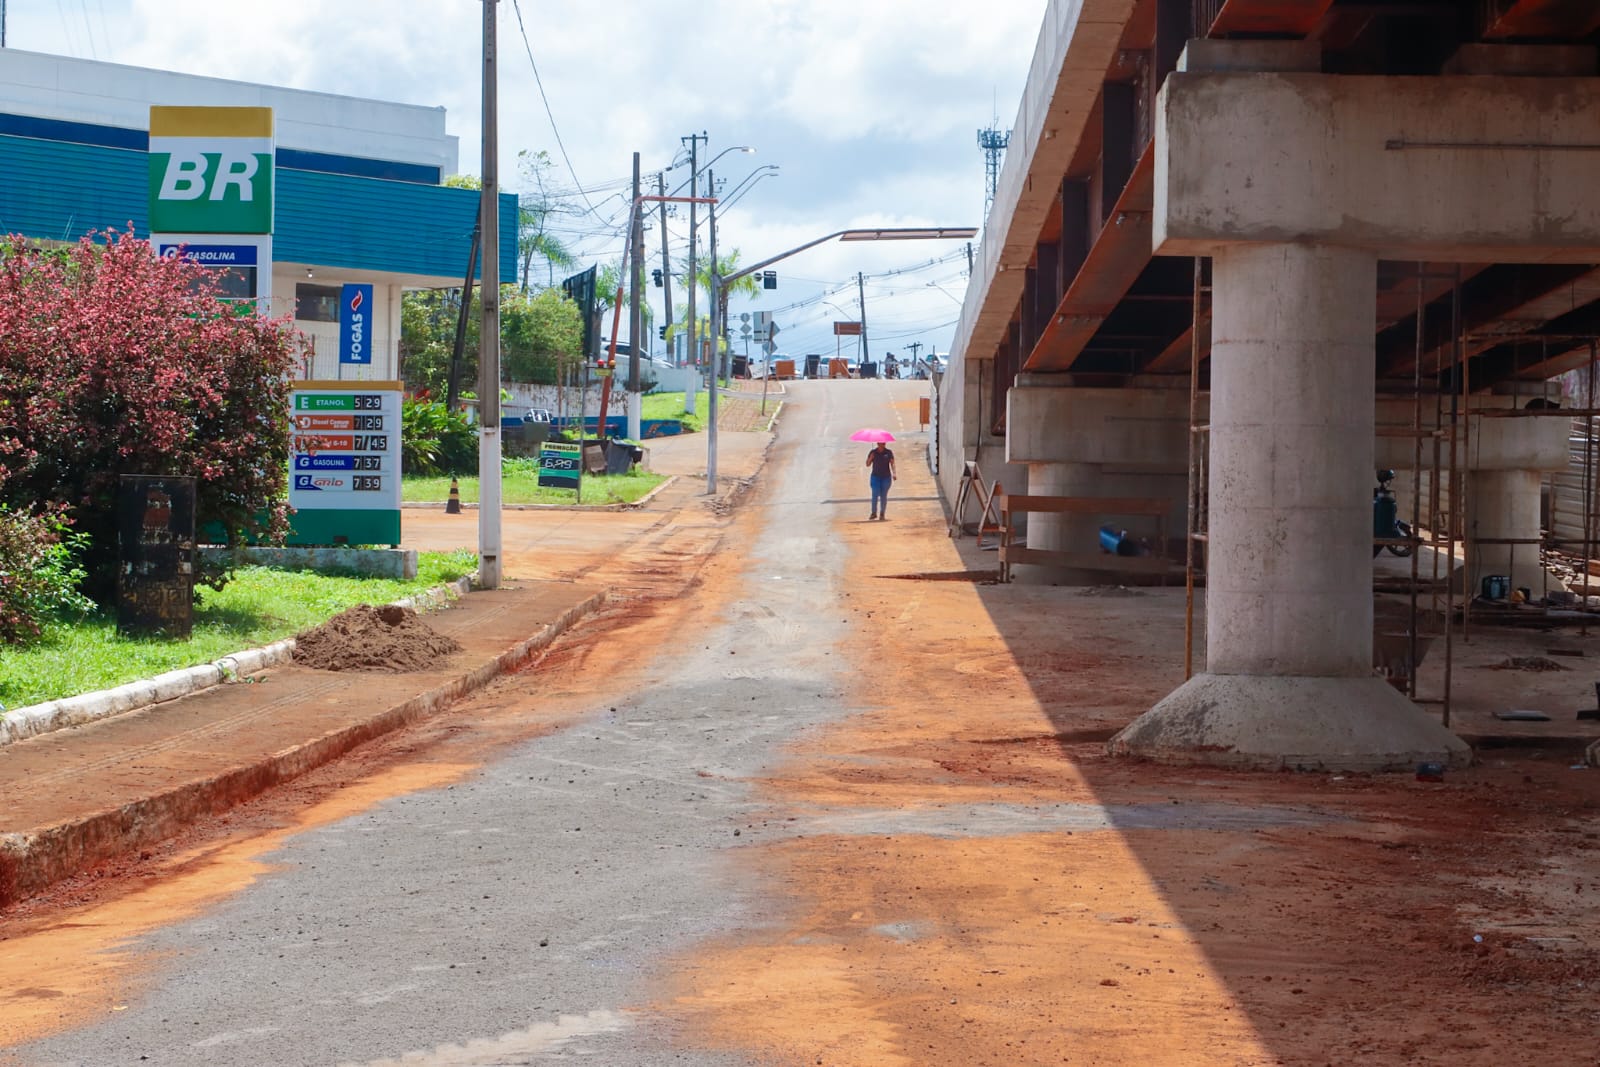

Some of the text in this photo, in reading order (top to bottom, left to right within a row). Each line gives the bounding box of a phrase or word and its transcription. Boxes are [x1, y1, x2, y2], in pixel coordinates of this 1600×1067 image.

[158, 152, 259, 201] BR
[186, 251, 236, 261] GASOLINA
[351, 313, 363, 360] FOGAS
[301, 397, 309, 408] E
[300, 458, 310, 466] G
[299, 476, 308, 486] G
